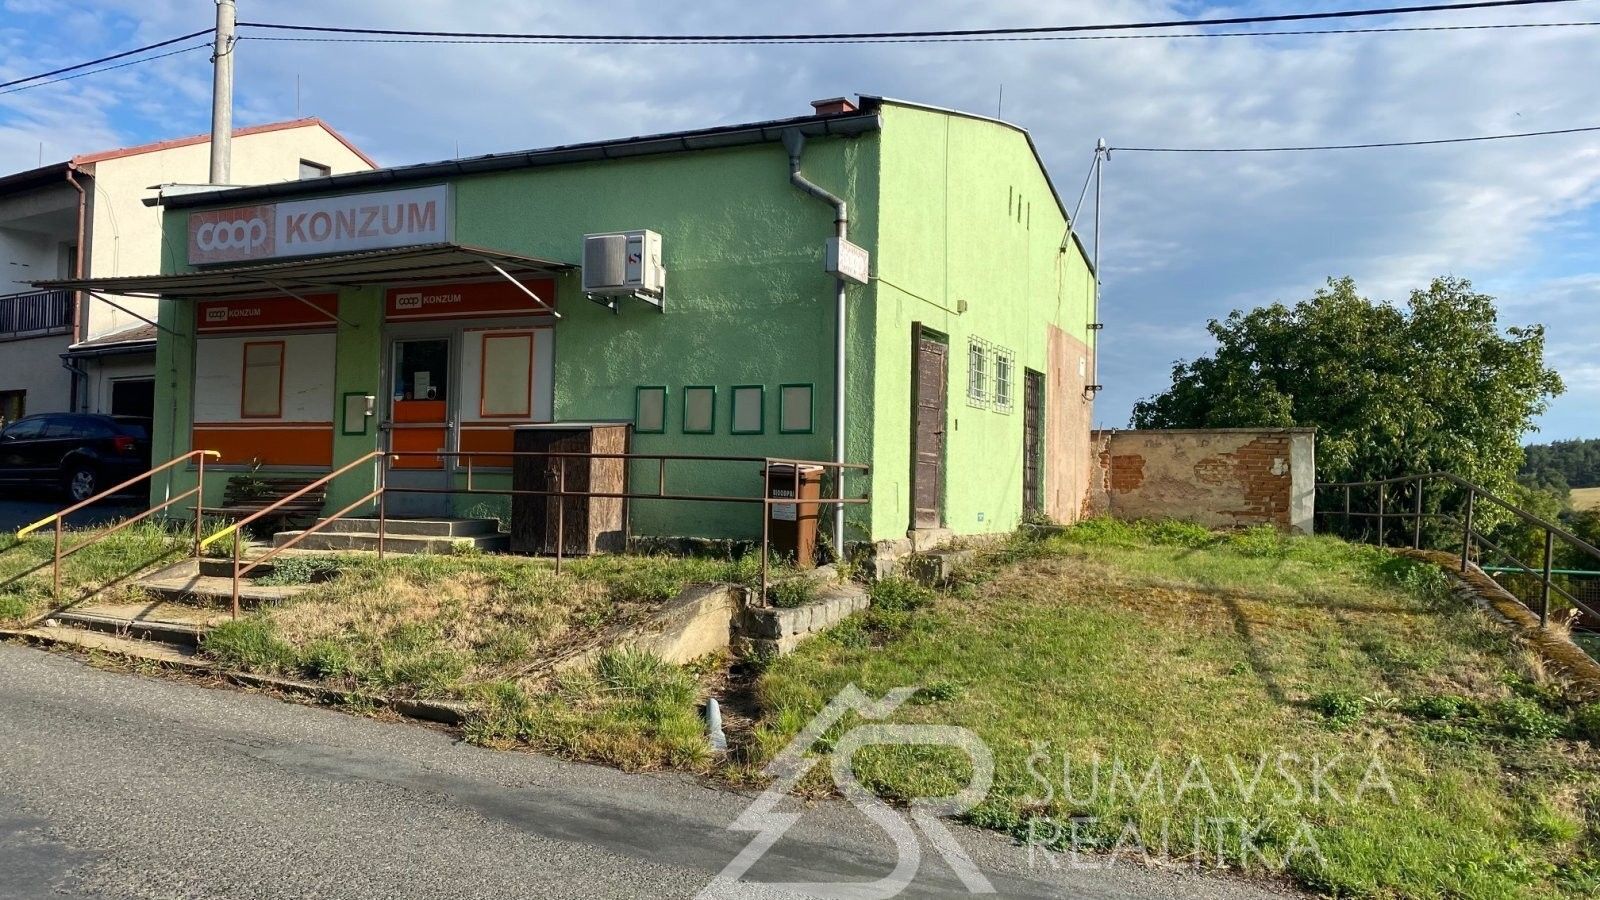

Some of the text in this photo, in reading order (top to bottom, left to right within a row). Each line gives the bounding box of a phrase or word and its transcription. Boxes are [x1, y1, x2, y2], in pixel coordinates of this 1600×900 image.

[196, 200, 436, 254] coop KONZUM
[398, 294, 461, 306] coop KONZUM
[228, 308, 261, 317] KONZUM
